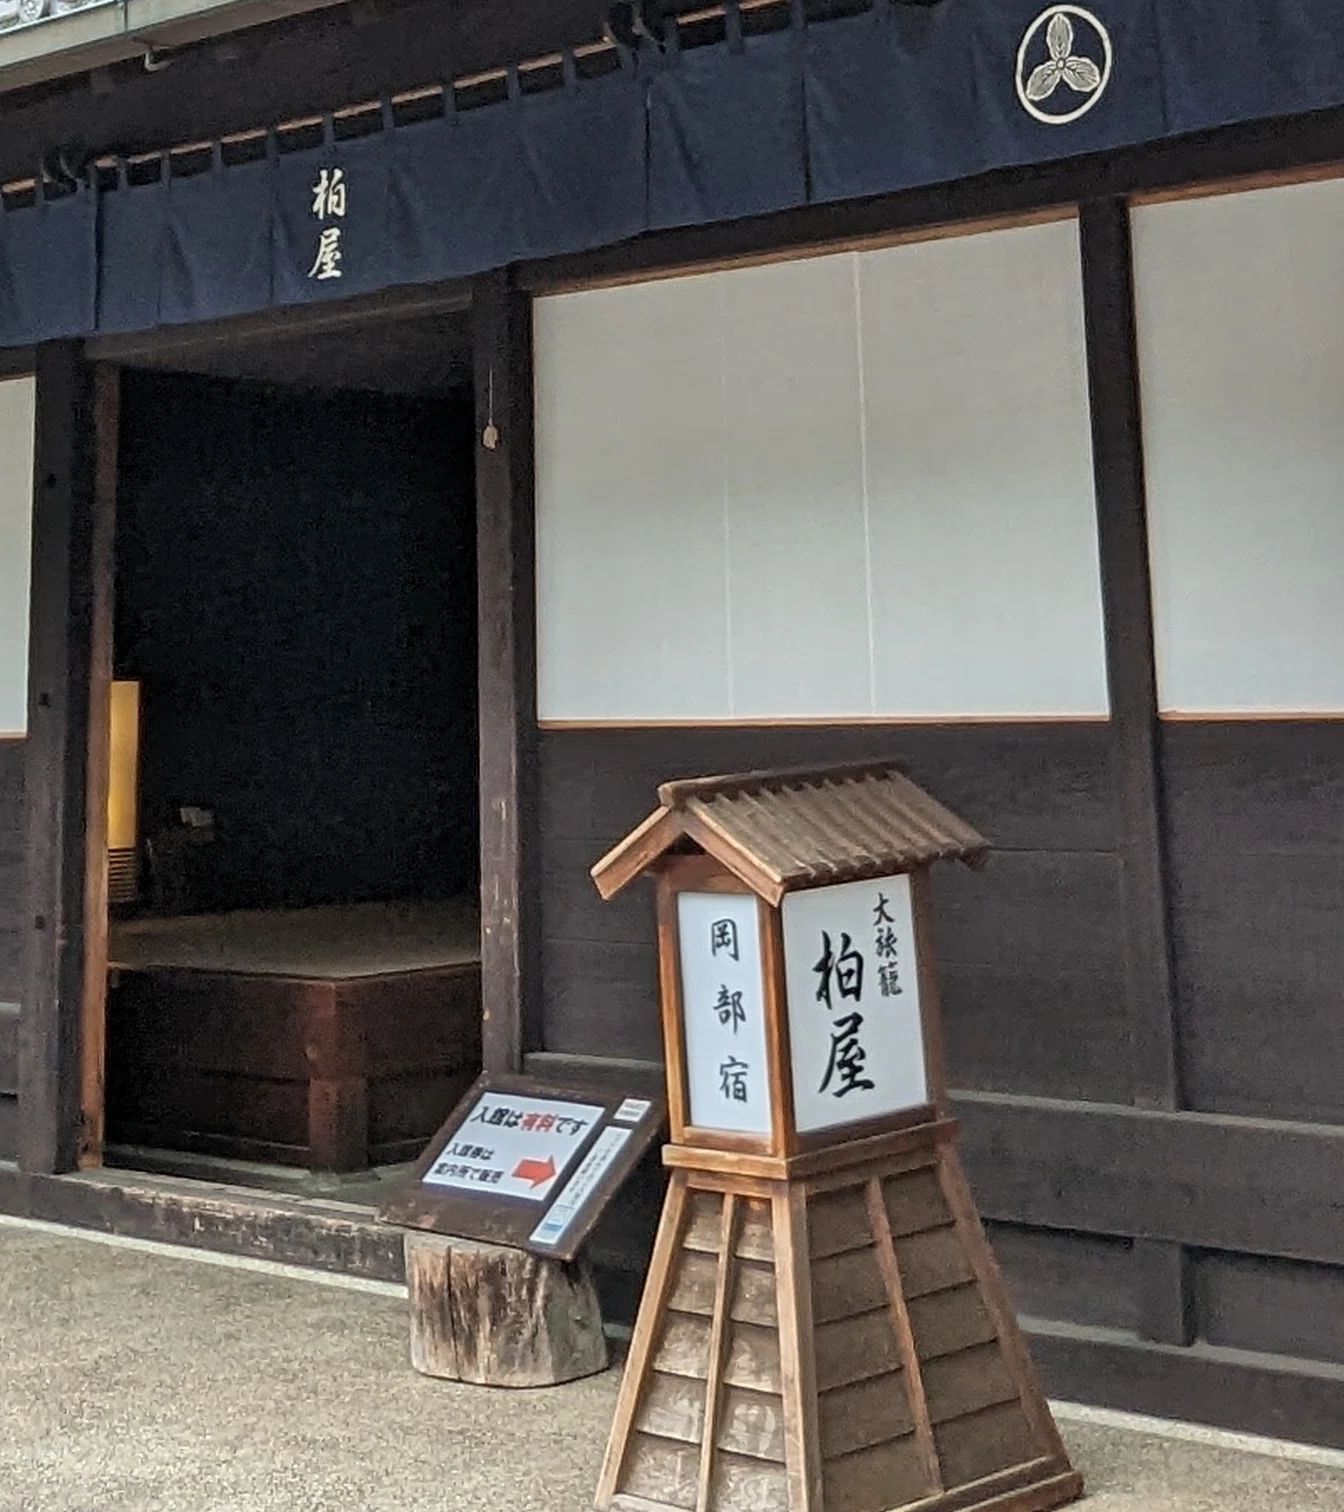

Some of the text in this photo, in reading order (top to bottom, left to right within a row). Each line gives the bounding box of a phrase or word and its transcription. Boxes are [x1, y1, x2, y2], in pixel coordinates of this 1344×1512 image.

[307, 168, 346, 280] 柏屋
[710, 918, 750, 1104] 岡部宿
[812, 930, 876, 1099] 柏屋
[470, 1105, 589, 1136] 入館は有料です
